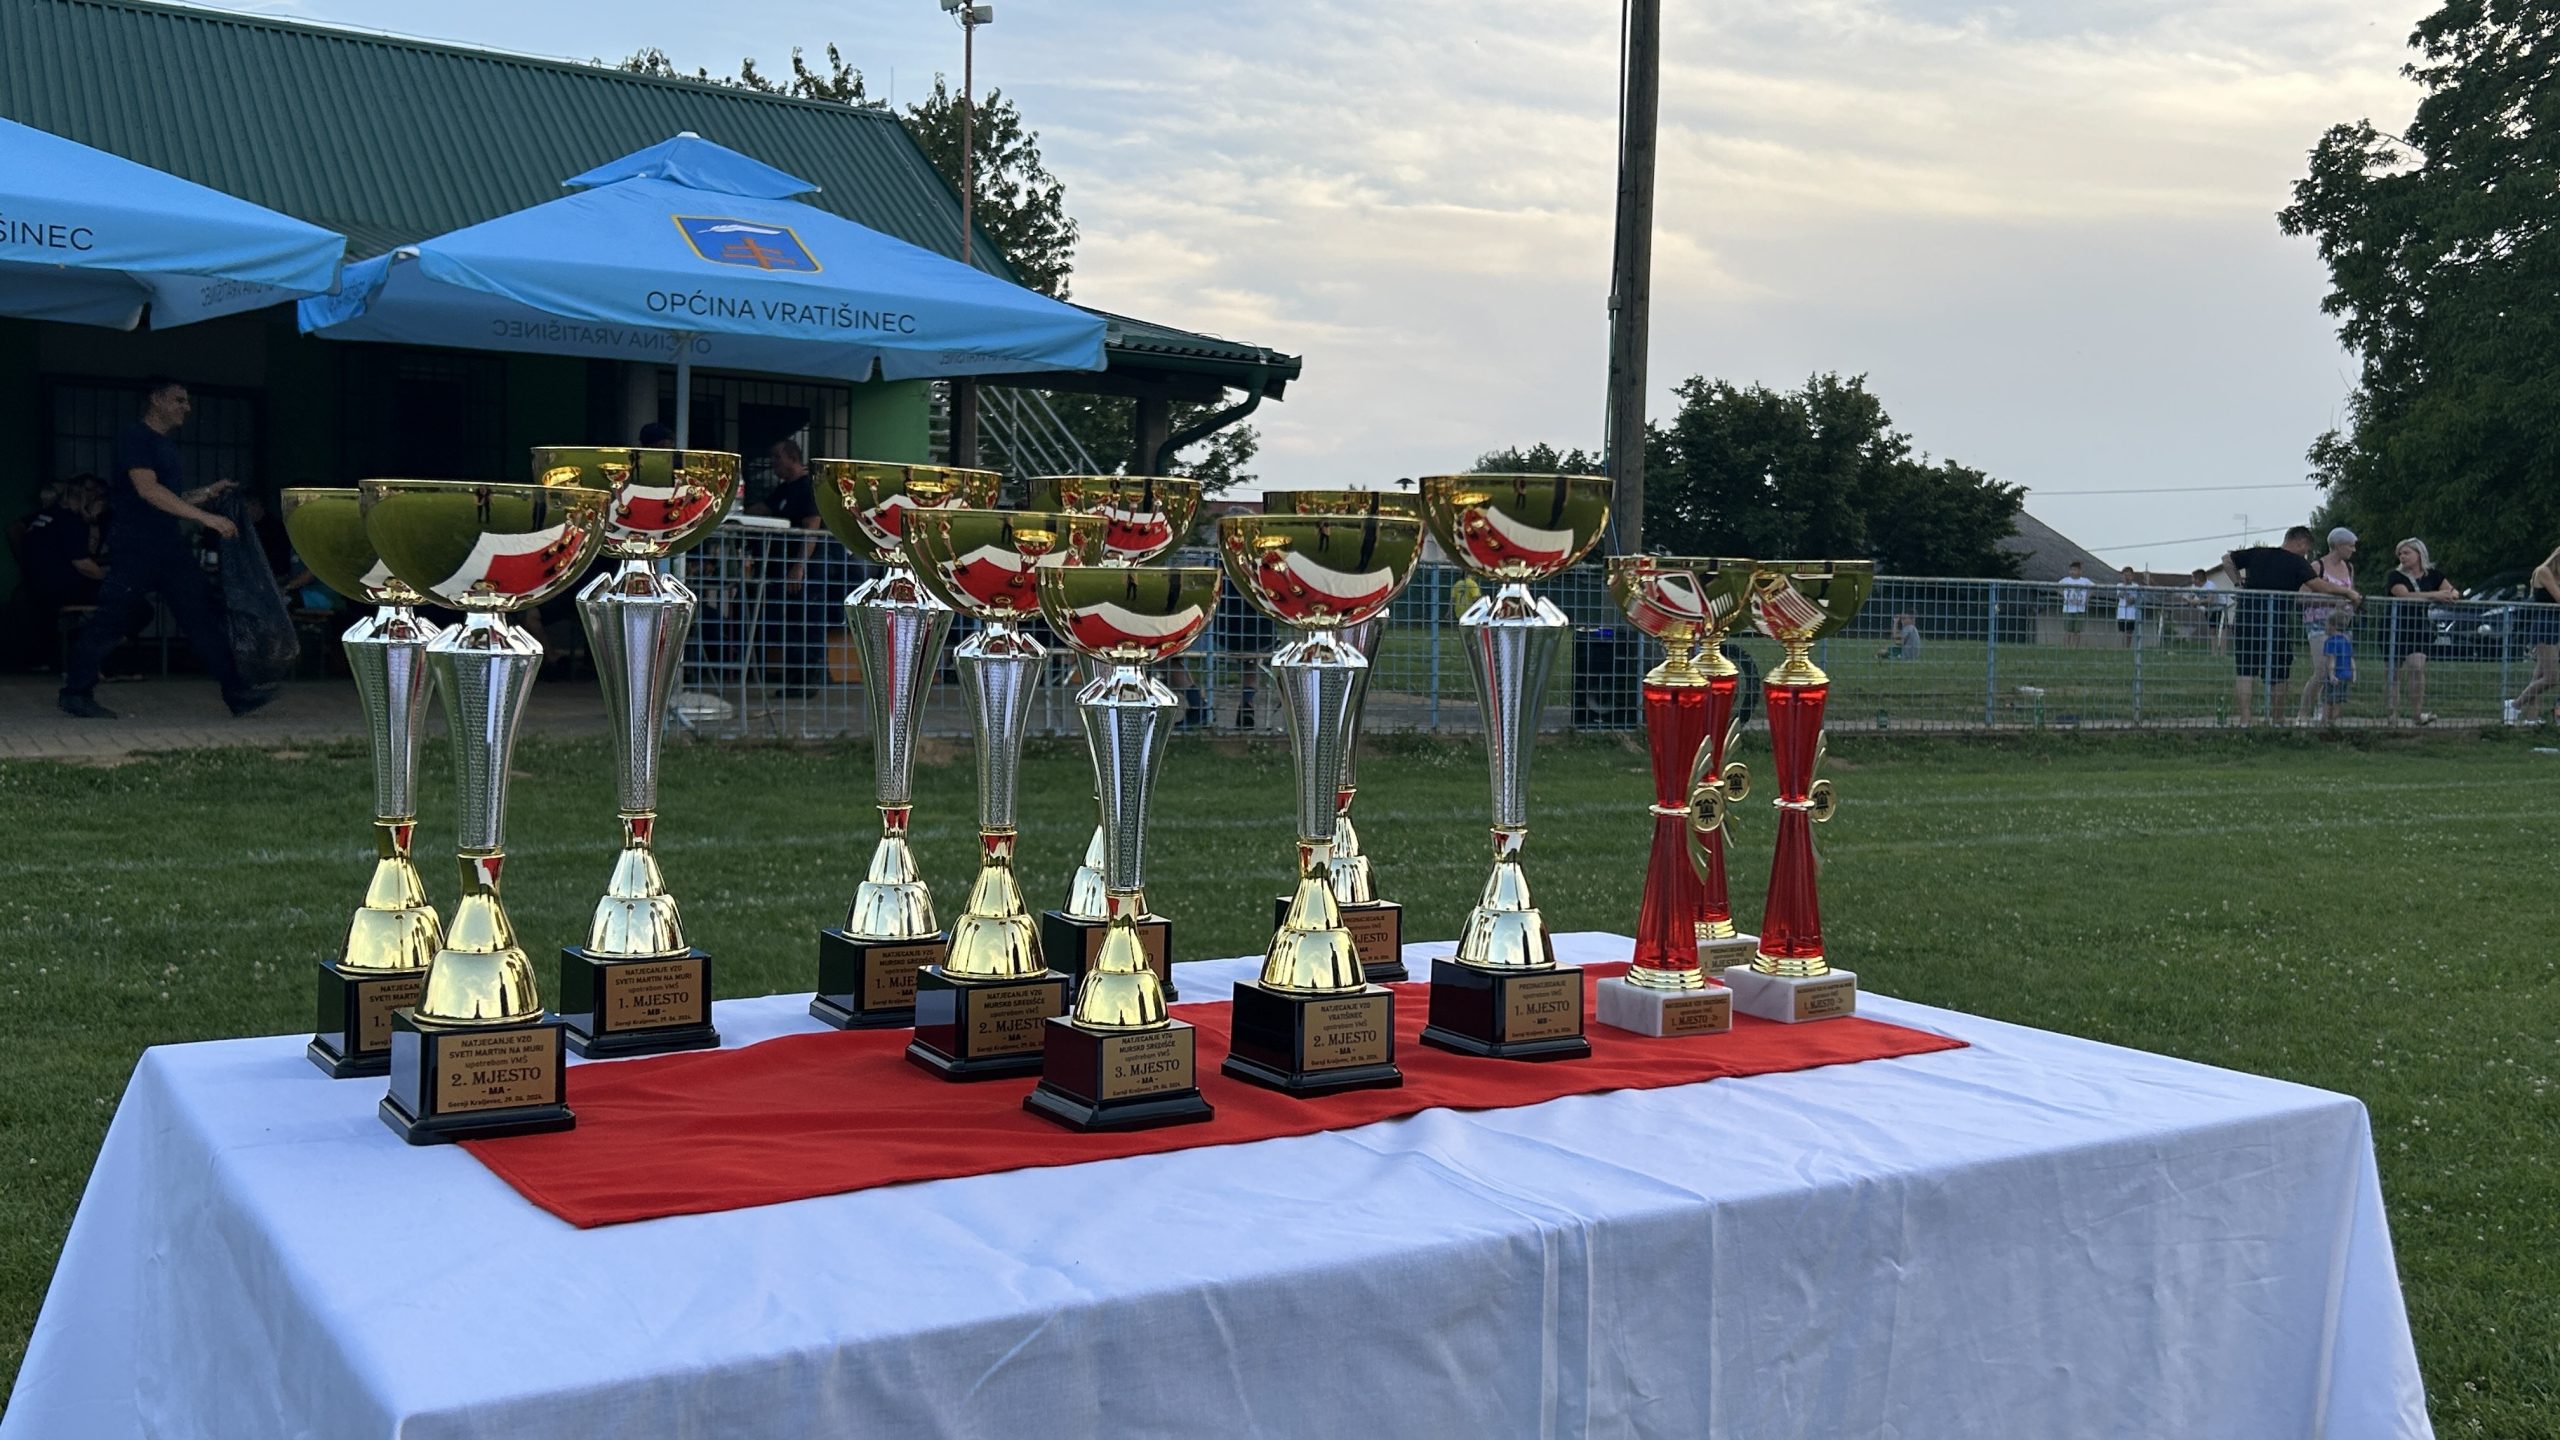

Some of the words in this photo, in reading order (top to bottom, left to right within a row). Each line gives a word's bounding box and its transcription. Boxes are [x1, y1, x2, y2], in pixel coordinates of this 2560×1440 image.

[646, 289, 755, 319] OPĆINA
[762, 301, 916, 335] VRATIŠINEC
[626, 966, 667, 975] NATJECANJE
[616, 978, 635, 986] SVETI
[636, 976, 662, 984] MARTIN
[876, 978, 885, 989] 1.
[890, 976, 917, 988] MJE
[380, 983, 420, 992] NATJECAN
[370, 995, 390, 1003] SVETI
[619, 998, 629, 1009] 1.
[633, 992, 689, 1008] MJESTO
[986, 990, 1028, 1000] NATJECANJE
[984, 1000, 1012, 1009] MURSKO
[1321, 1004, 1358, 1012] NATJECANJE
[1515, 1005, 1523, 1016] 1.
[1526, 1000, 1570, 1015] MJESTO
[374, 1016, 385, 1027] 1.
[1328, 1011, 1363, 1021] VRATIŠINEC
[1679, 1015, 1708, 1026] MJESTO
[980, 1022, 992, 1034] 2.
[461, 1036, 515, 1047] NATJECANJE
[1122, 1035, 1160, 1044] NATJECANJE
[1314, 1035, 1324, 1048] 2.
[1328, 1030, 1377, 1046] MJESTO
[449, 1050, 473, 1059] SVETI
[475, 1047, 506, 1057] MARTIN
[509, 1046, 521, 1054] NA
[523, 1044, 544, 1053] MURI
[1120, 1045, 1145, 1053] MURSKO
[465, 1058, 509, 1069] upotrebom
[511, 1055, 528, 1065] VMŠ
[1115, 1066, 1126, 1078] 3.
[1130, 1059, 1180, 1076] MJESTO
[452, 1073, 467, 1087] 2.
[472, 1066, 541, 1085] MJESTO
[489, 1086, 505, 1095] MA
